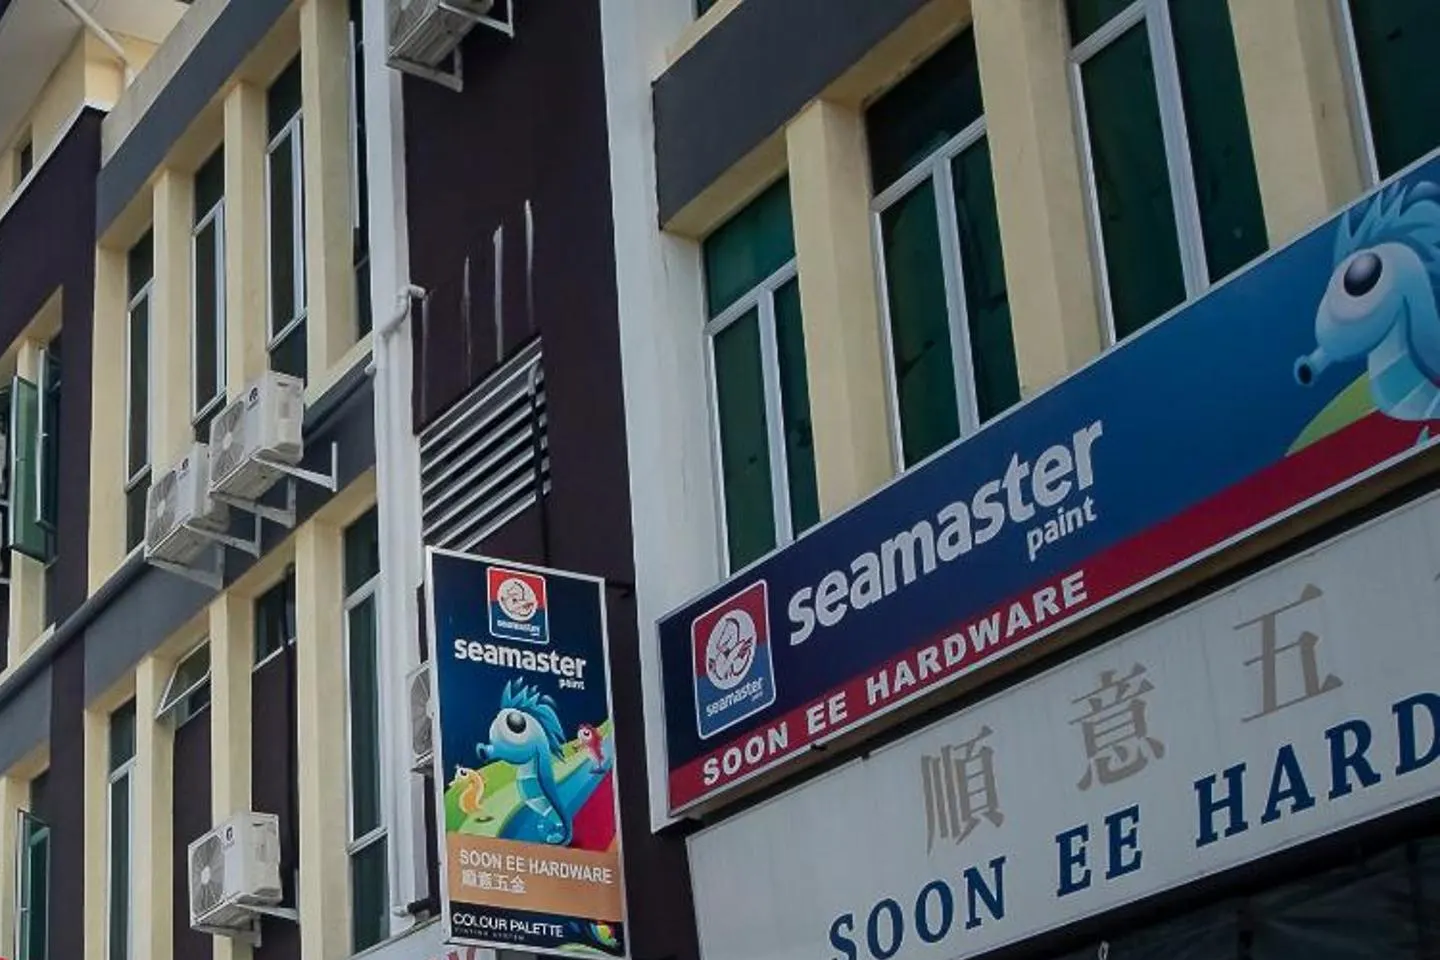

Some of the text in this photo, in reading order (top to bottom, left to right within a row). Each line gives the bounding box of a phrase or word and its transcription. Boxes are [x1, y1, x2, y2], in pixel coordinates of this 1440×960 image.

[787, 419, 1104, 646] seamaster
[1026, 496, 1097, 562] paint
[453, 636, 587, 681] seamaster
[558, 677, 585, 692] paint
[702, 569, 1088, 787] SOON EE HARDWARE
[920, 573, 1440, 857] 順意五
[1054, 803, 1145, 898] EE
[1194, 691, 1440, 849] HARD
[460, 847, 614, 886] SOON EE HARDWARE
[452, 911, 565, 940] COLOUR PALETTE
